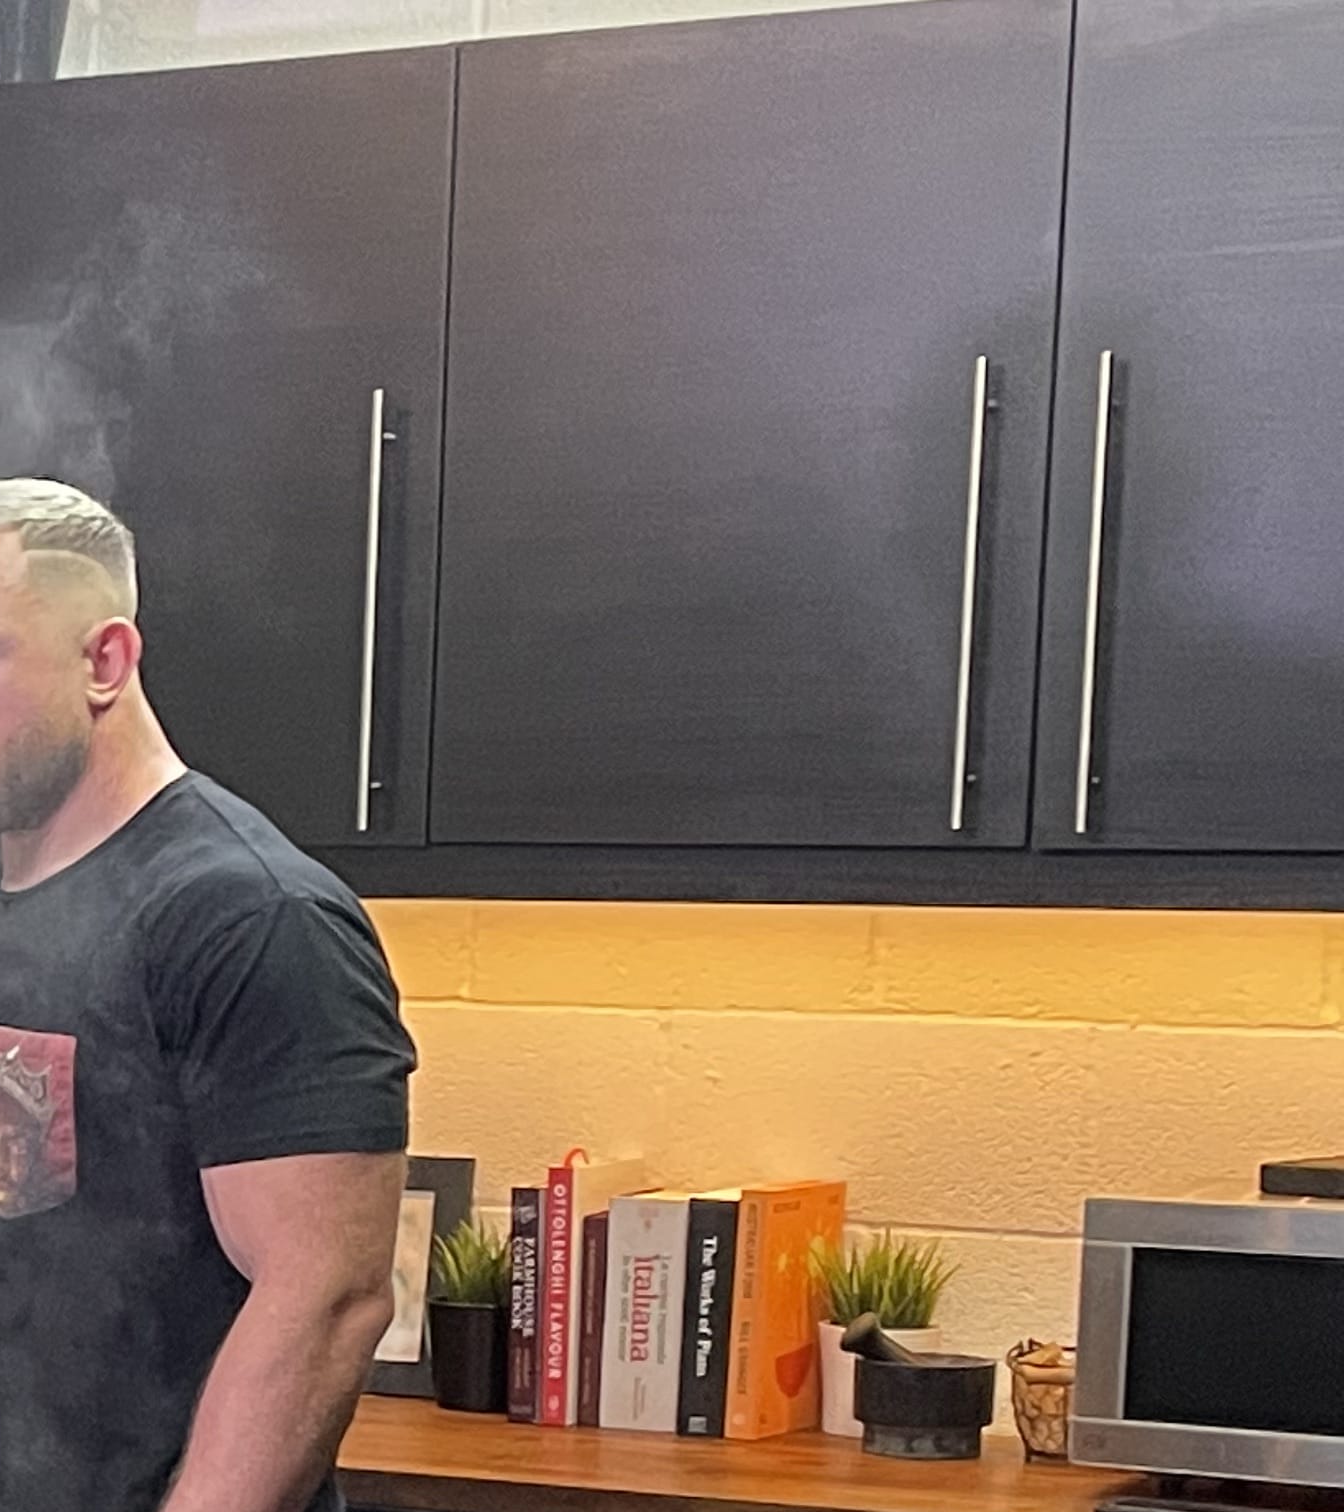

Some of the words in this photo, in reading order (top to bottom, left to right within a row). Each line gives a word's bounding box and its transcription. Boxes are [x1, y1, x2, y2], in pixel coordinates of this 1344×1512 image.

[550, 1183, 567, 1295] OTTOLENGHI
[702, 1235, 718, 1266] The
[511, 1284, 523, 1330] BOOK
[522, 1237, 536, 1338] FARMHOUSE
[699, 1268, 716, 1316] Works
[548, 1302, 565, 1379] FLAVOUR
[698, 1318, 712, 1335] of
